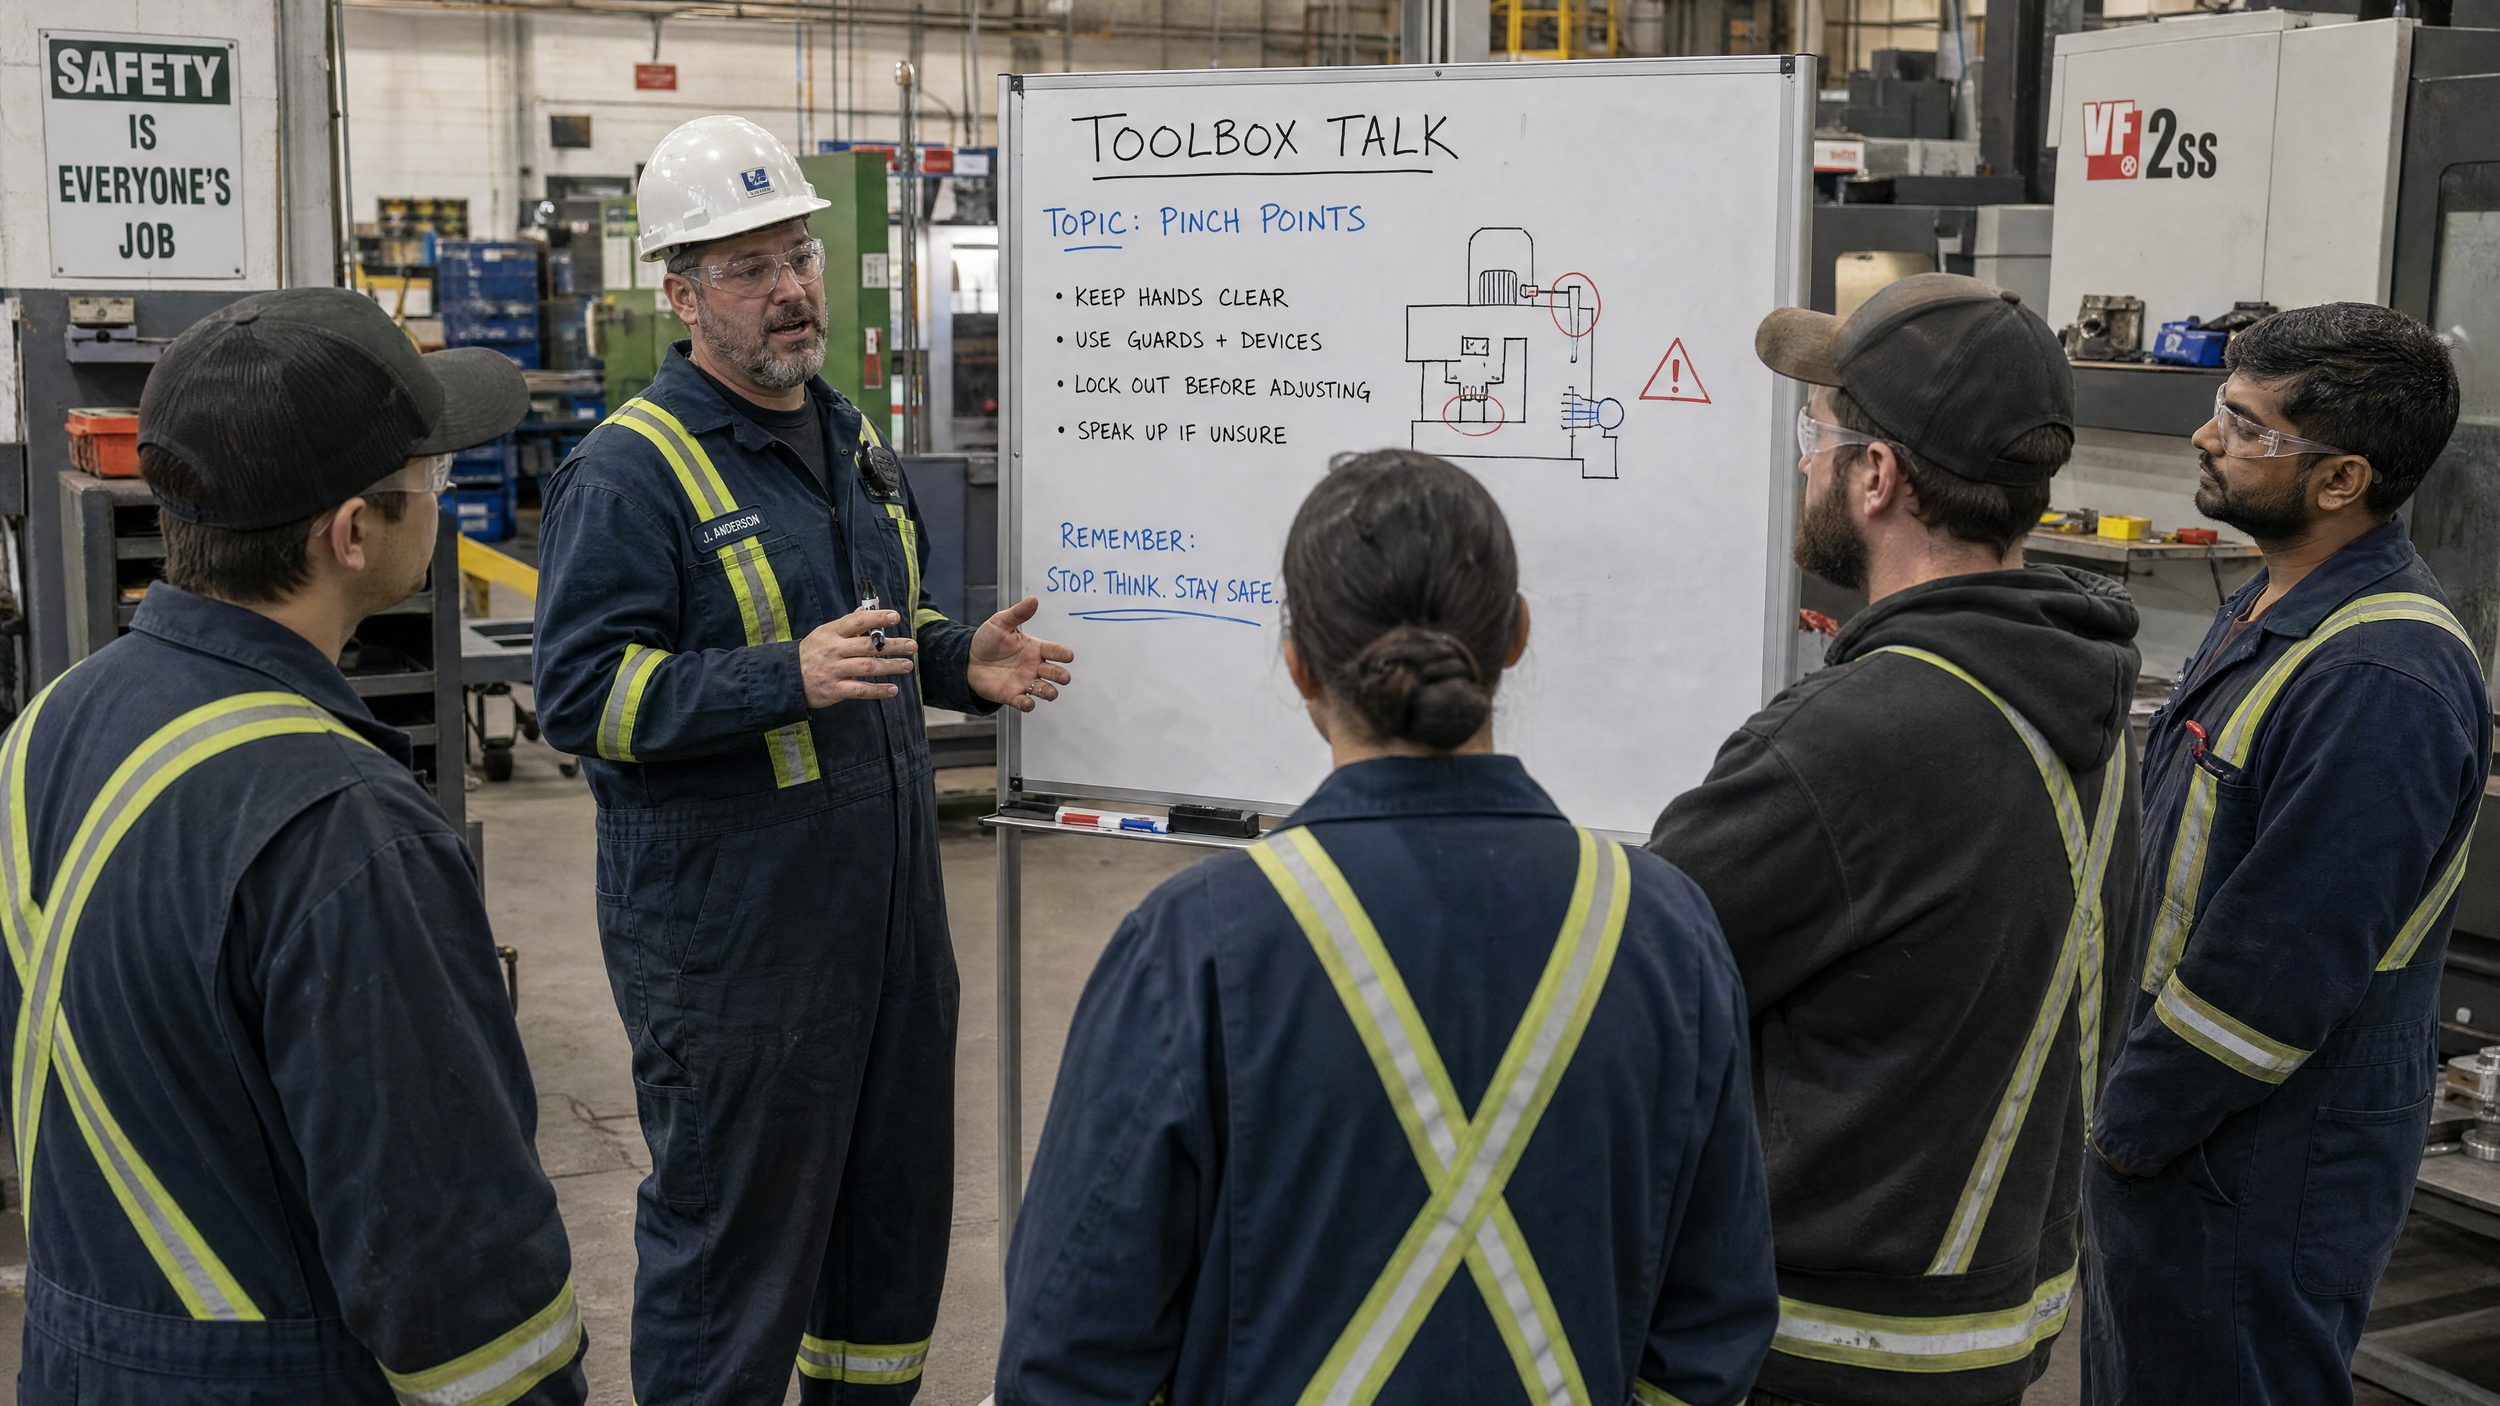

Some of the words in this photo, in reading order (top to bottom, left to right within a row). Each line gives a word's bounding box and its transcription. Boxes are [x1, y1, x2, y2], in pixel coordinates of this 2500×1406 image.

[57, 48, 221, 97] SAFETY
[129, 114, 156, 150] IS
[1071, 113, 1298, 162] TOOLBOX
[1327, 114, 1458, 159] TALK
[2083, 100, 2134, 156] VF
[58, 165, 231, 206] EVERYONE'S
[1043, 208, 1139, 237] TOPIC:
[1160, 207, 1239, 236] PINCH
[1260, 203, 1365, 233] POINTS
[119, 222, 175, 259] JOB
[1076, 286, 1125, 307] KEEP
[1139, 287, 1202, 306] HANDS
[1219, 288, 1289, 308] CLEAR
[1076, 331, 1111, 349] USE
[1128, 331, 1204, 350] GUARDS
[1216, 334, 1227, 347] +
[1241, 331, 1322, 351] DEVICES
[1076, 375, 1121, 394] LOCK
[1132, 376, 1170, 394] OUT
[1185, 376, 1256, 396] BEFORE
[1270, 379, 1371, 403] ADJUSTING
[1078, 421, 1134, 441] SPEAK
[1146, 423, 1167, 441] UP
[1180, 424, 1196, 442] IF
[1211, 425, 1287, 444] UNSURE
[703, 531, 713, 544] J.
[713, 514, 760, 539] ANDERSON
[1061, 522, 1194, 552] REMEMBER:
[1047, 566, 1096, 593] STOP.
[1103, 570, 1166, 598] THINK.
[1175, 575, 1218, 603] STAY
[1227, 579, 1279, 605] SAFE.
